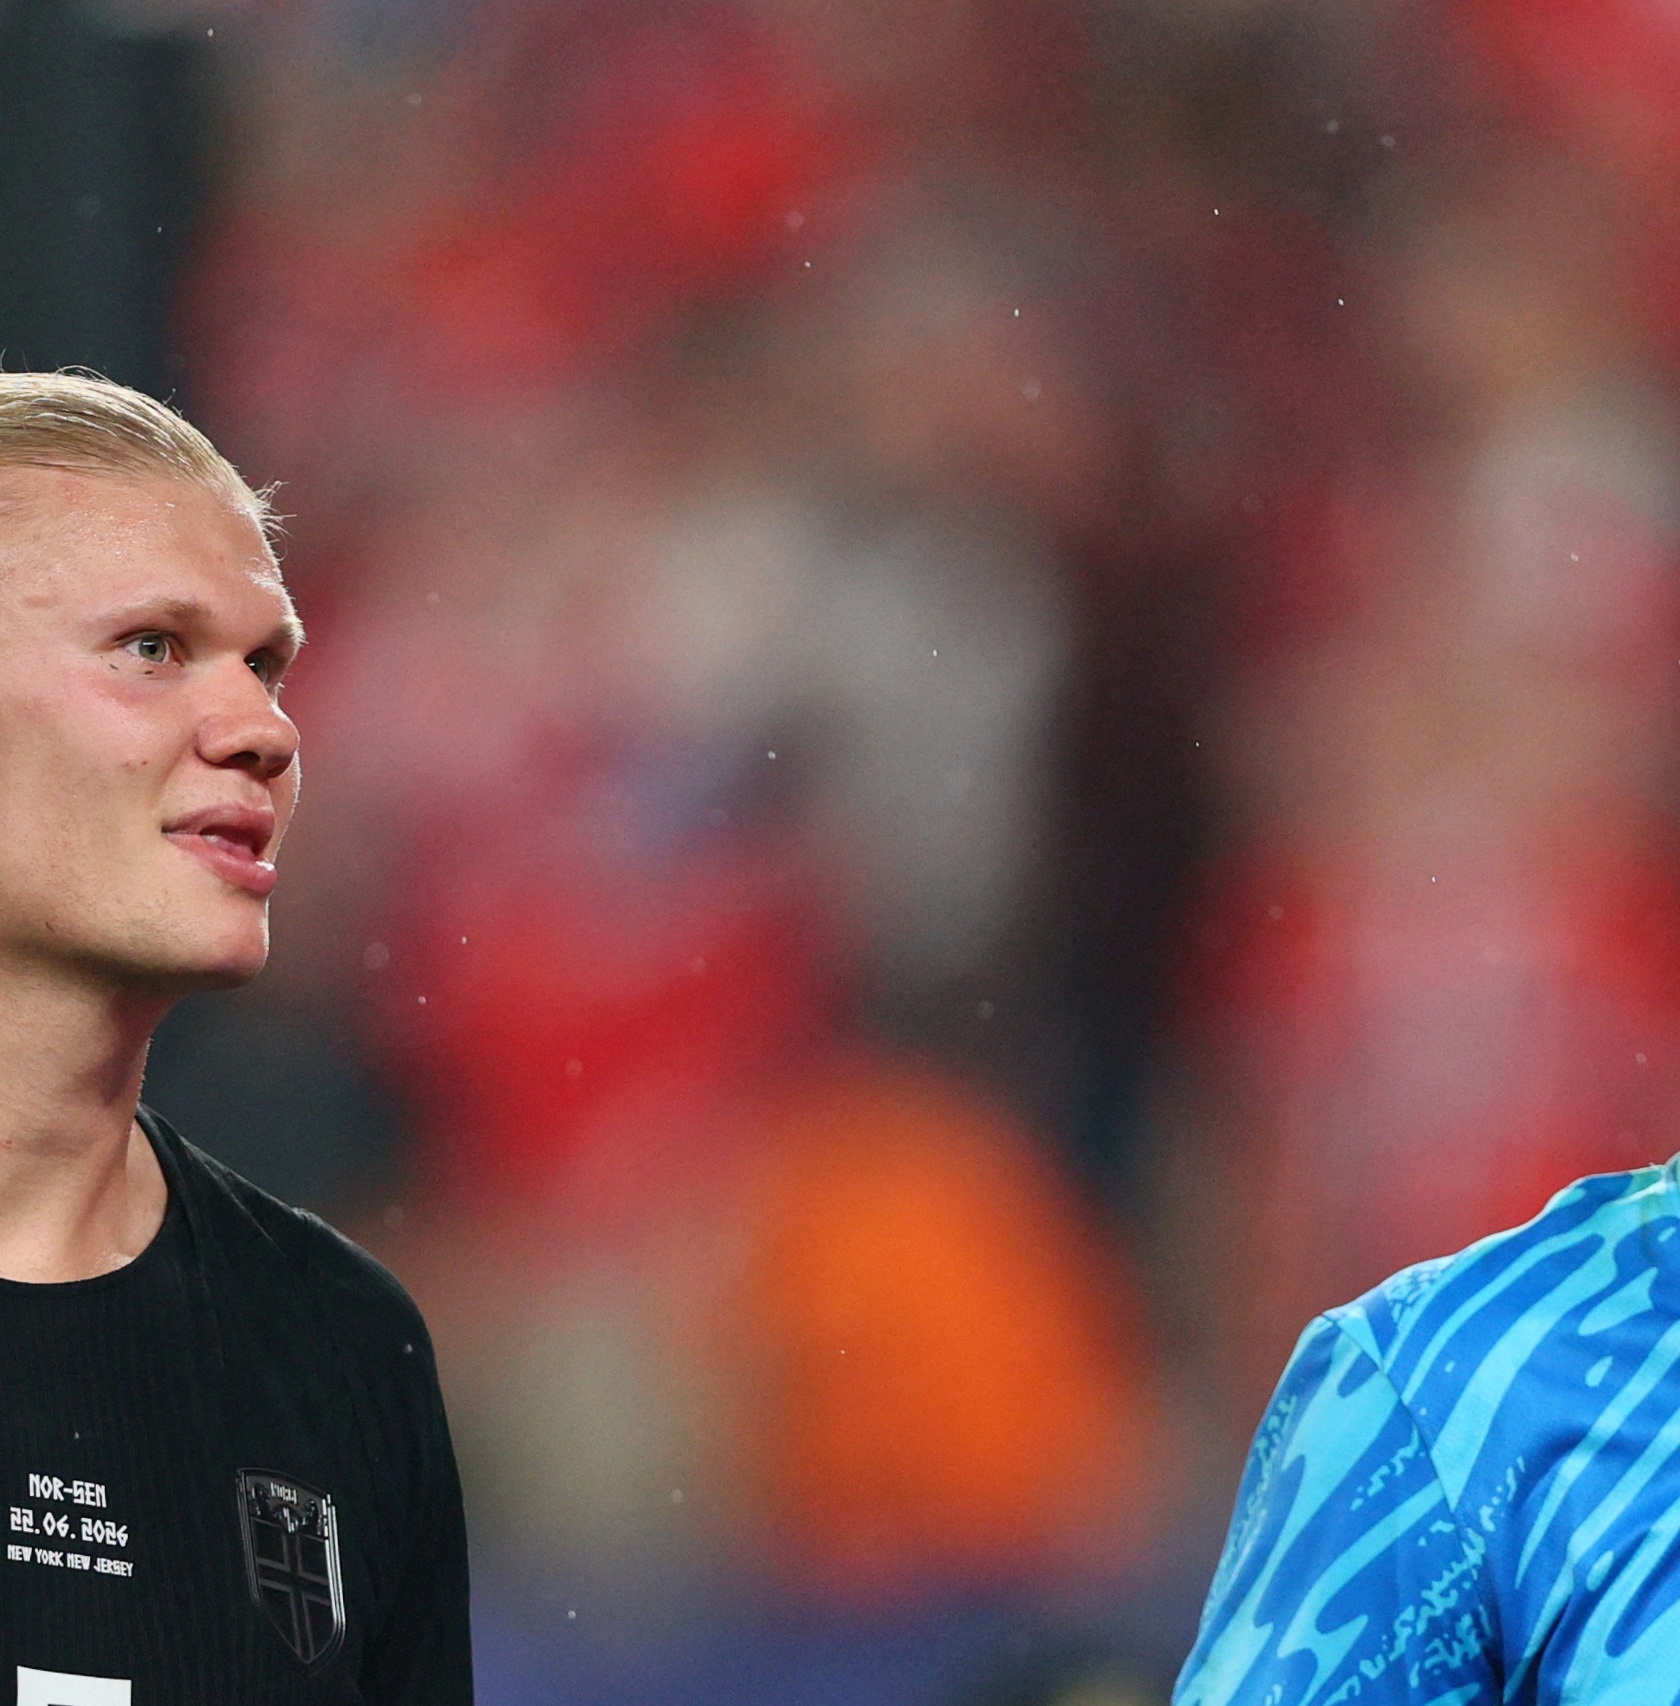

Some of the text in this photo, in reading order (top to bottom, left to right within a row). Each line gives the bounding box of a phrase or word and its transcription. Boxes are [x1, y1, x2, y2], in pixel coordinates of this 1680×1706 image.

[29, 1473, 107, 1508] NOR-SEN
[7, 1544, 134, 1577] NEW YORK NEW JERSEY
